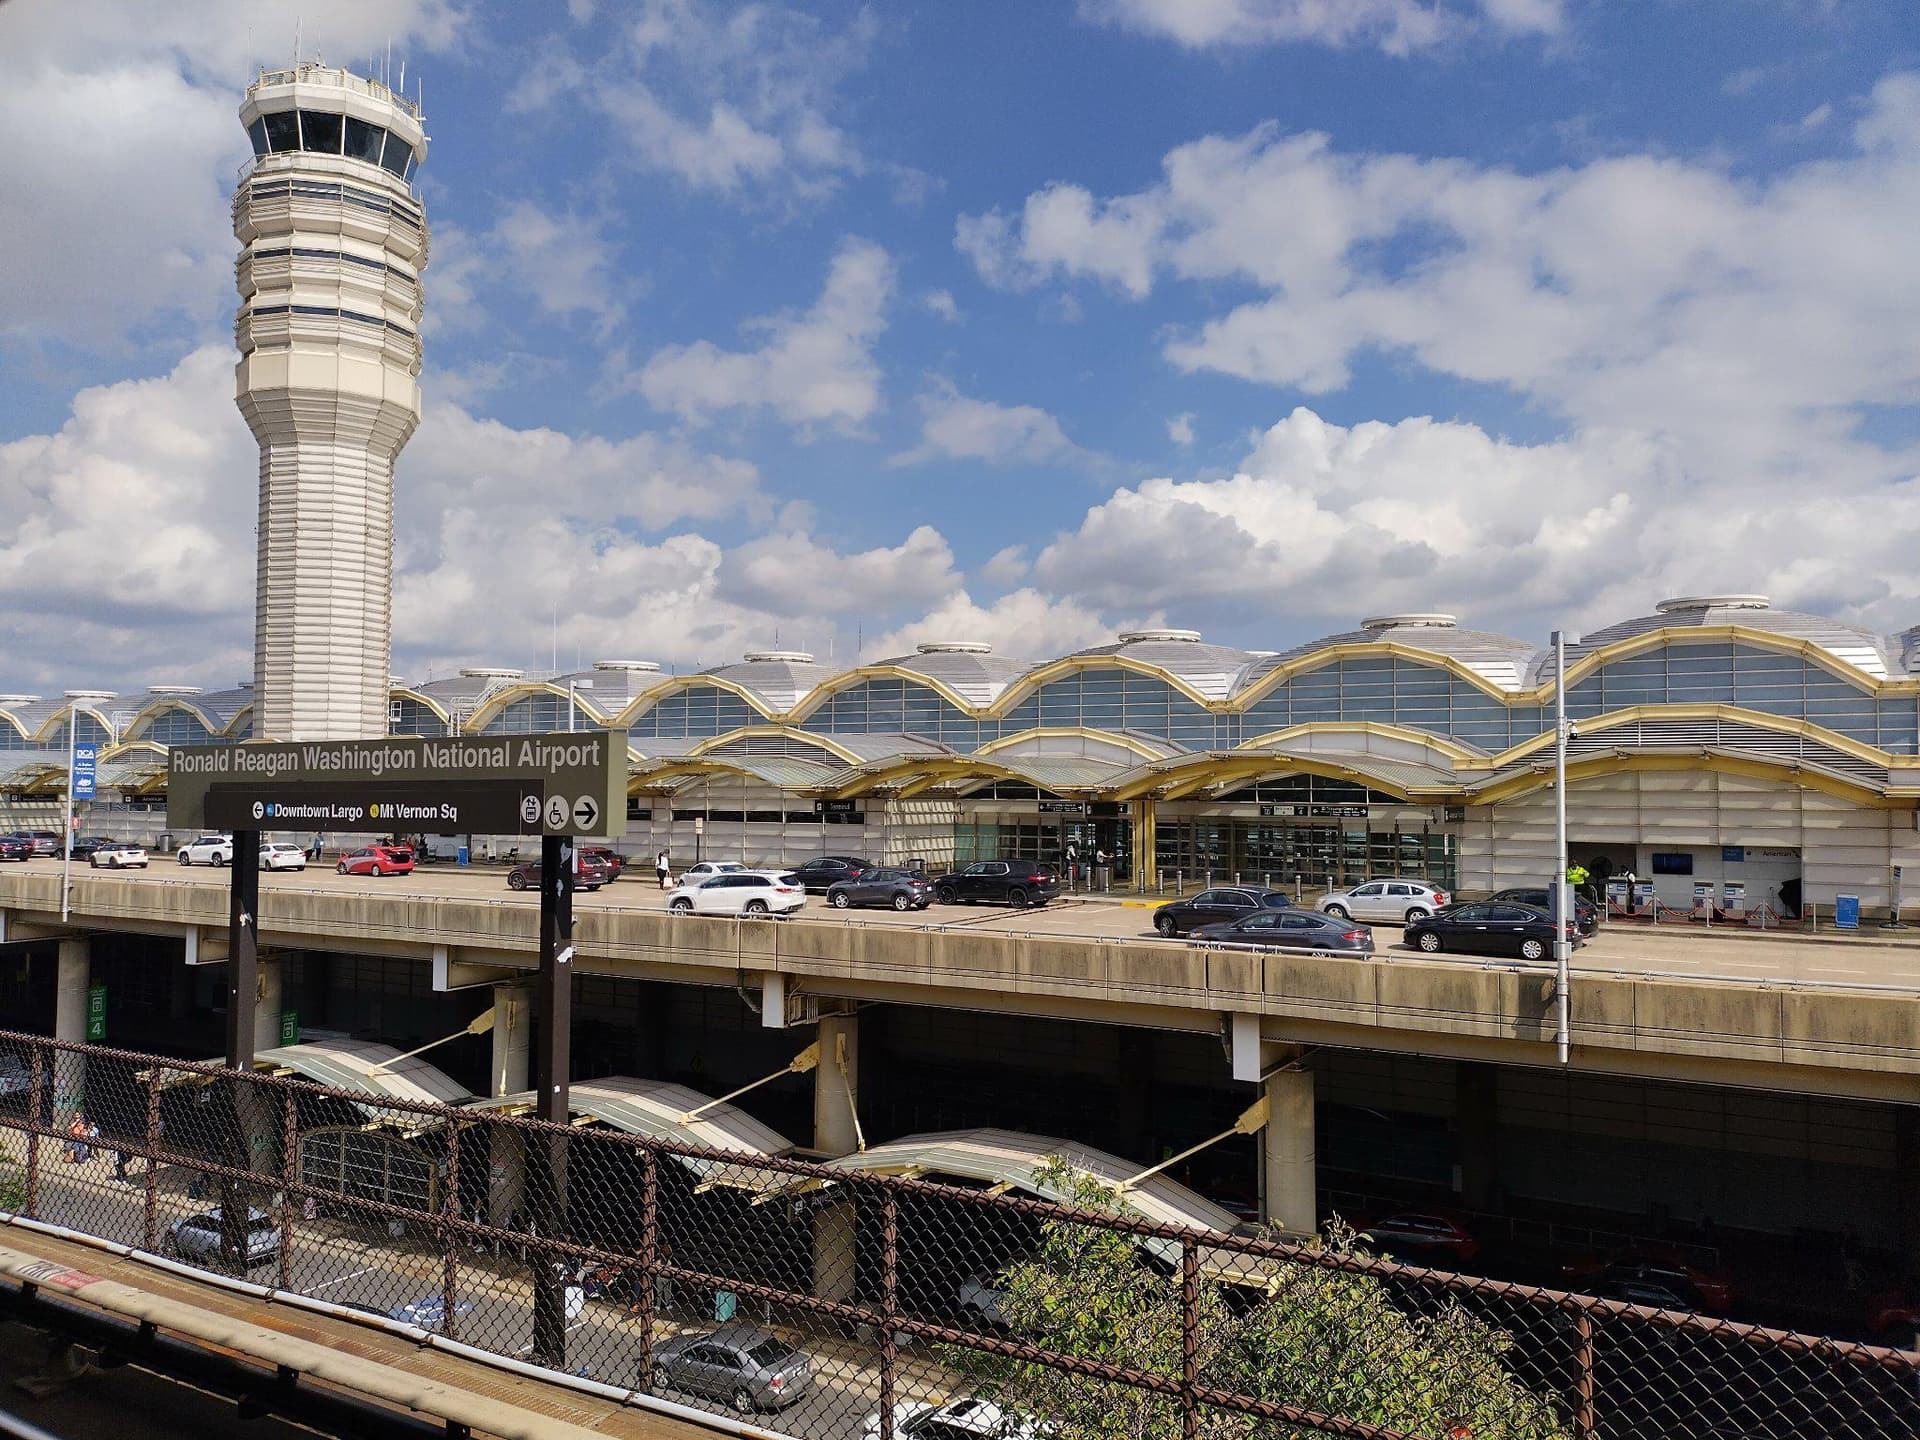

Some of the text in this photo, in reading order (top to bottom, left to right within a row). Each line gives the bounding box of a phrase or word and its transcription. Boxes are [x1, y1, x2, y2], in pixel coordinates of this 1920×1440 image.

[173, 740, 600, 777] Ronald Reagan Washington National Airport
[274, 804, 329, 818] Downtown
[331, 804, 363, 822] Largo
[380, 803, 394, 818] Mt
[396, 804, 438, 818] Vernon
[440, 803, 458, 822] Sq
[92, 1022, 102, 1035] 4
